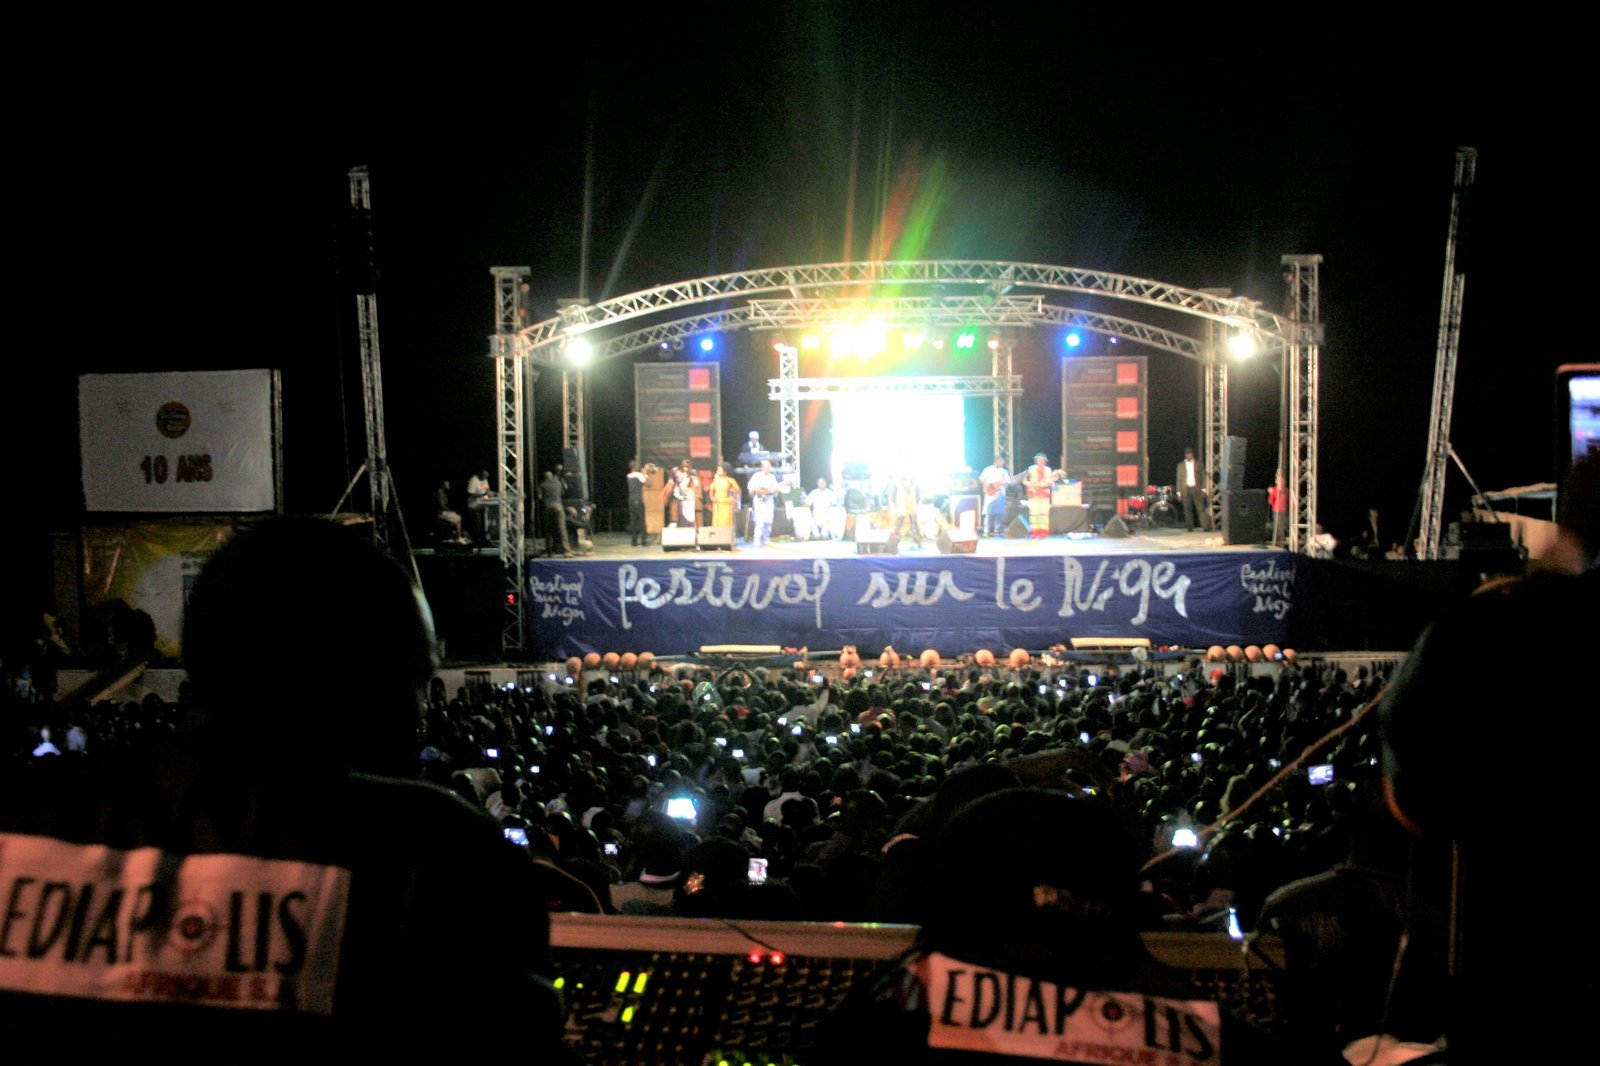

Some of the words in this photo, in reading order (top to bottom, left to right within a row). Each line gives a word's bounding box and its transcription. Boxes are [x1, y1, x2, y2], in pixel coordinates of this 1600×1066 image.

[140, 455, 169, 484] 10
[176, 454, 213, 483] ANS
[858, 570, 975, 608] sur
[996, 556, 1042, 612] le
[1057, 556, 1191, 626] Niger
